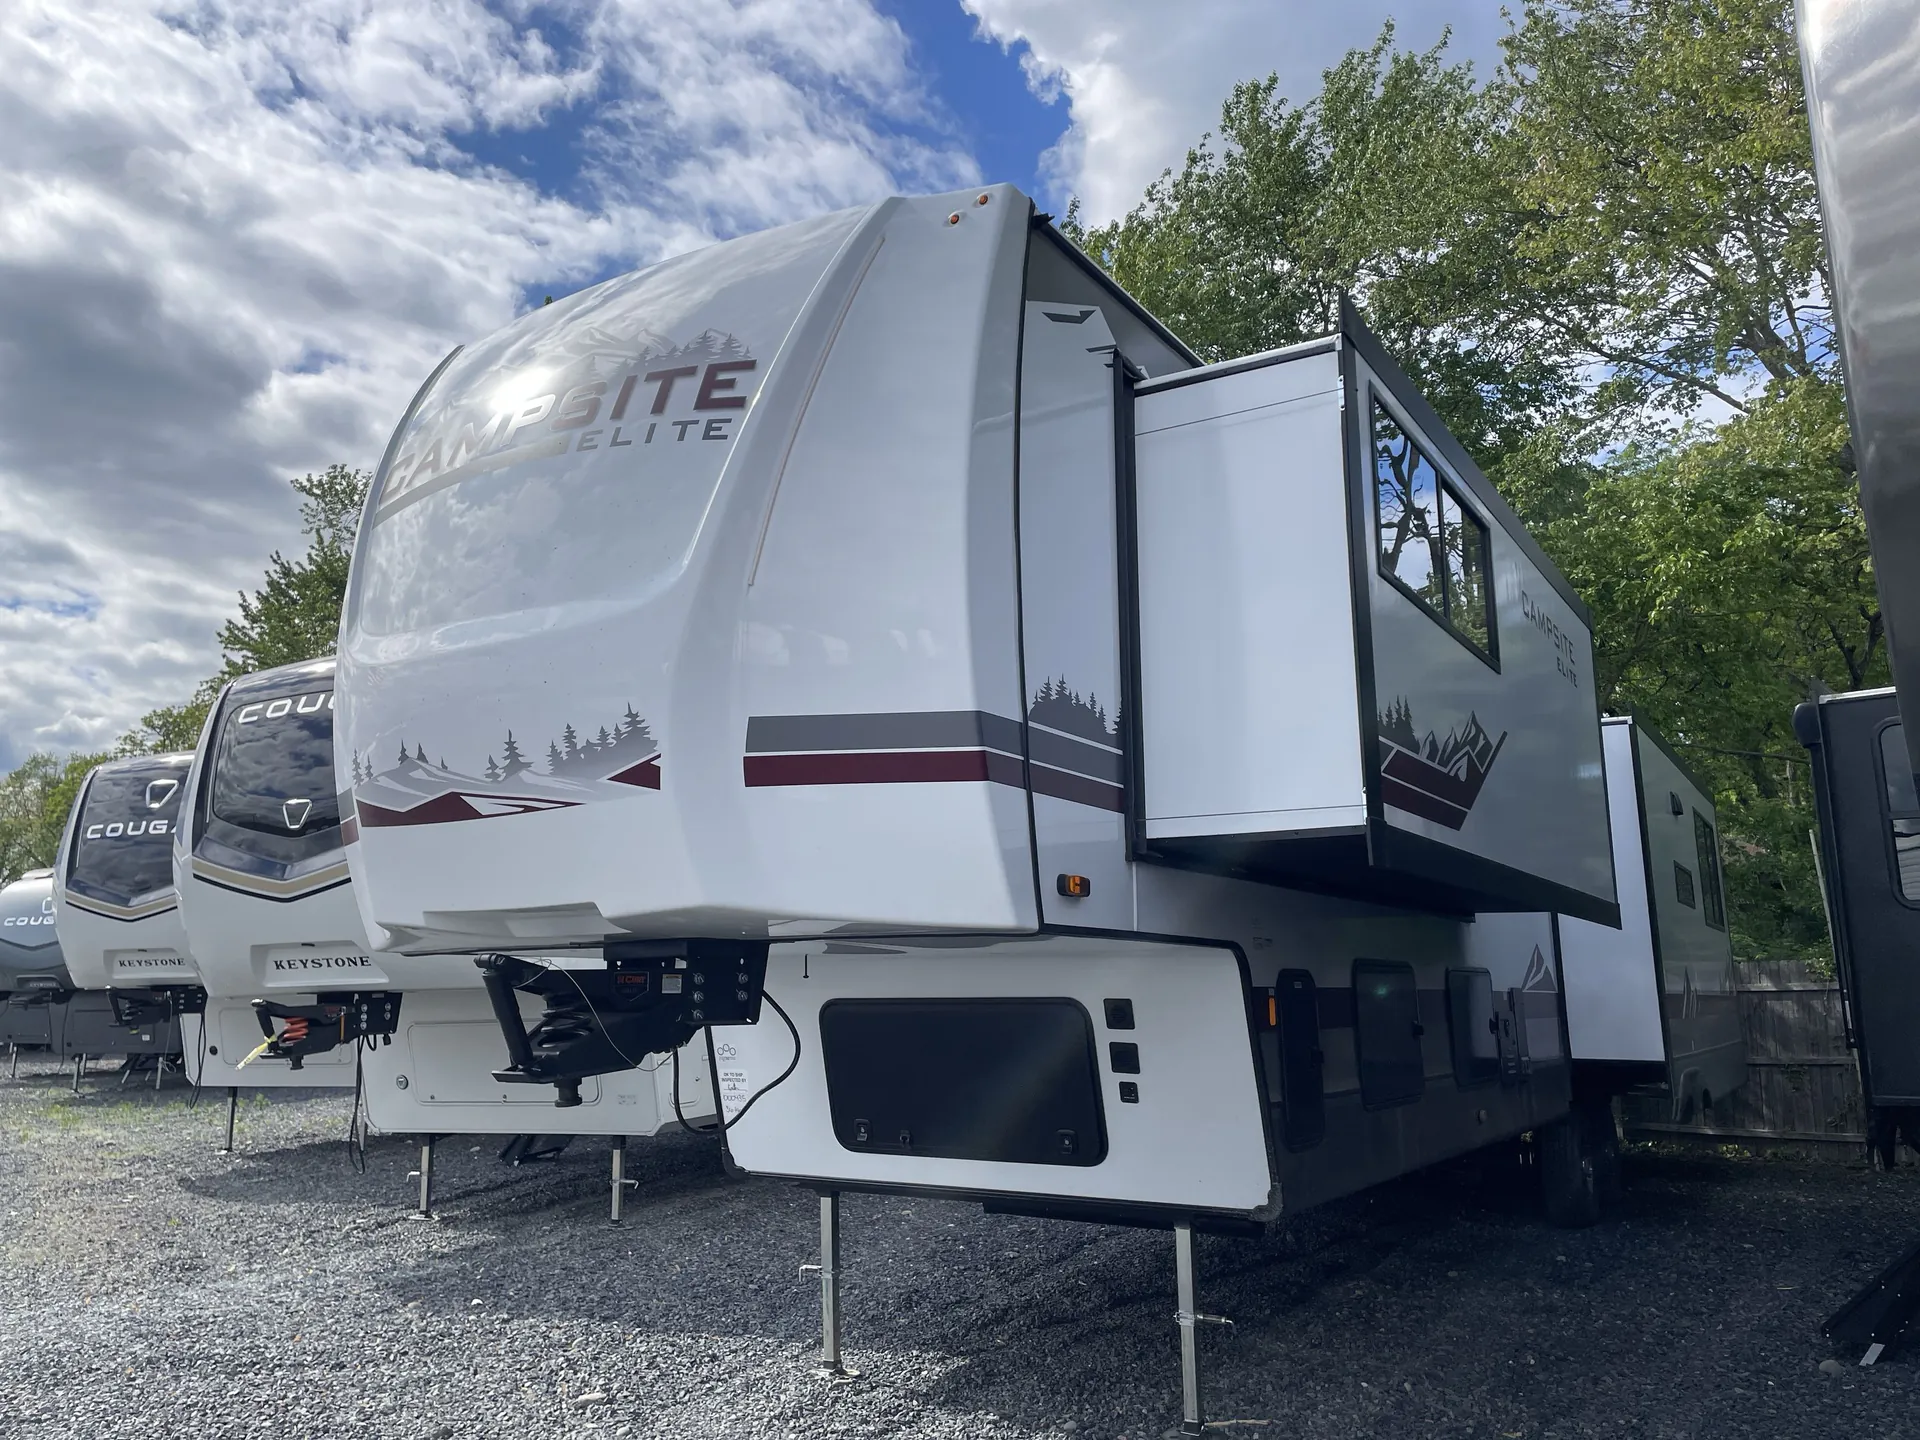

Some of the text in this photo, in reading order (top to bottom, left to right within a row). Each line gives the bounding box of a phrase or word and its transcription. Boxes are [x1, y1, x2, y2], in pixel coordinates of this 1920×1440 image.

[382, 359, 757, 499] CAMPSITE
[576, 418, 732, 452] ELITE
[1521, 590, 1576, 666] CAMPSITE
[1556, 656, 1578, 688] ELITE
[239, 694, 334, 724] COU
[86, 820, 176, 839] COUG
[118, 958, 186, 968] KEYSTONE
[273, 956, 372, 971] KEYSTONE
